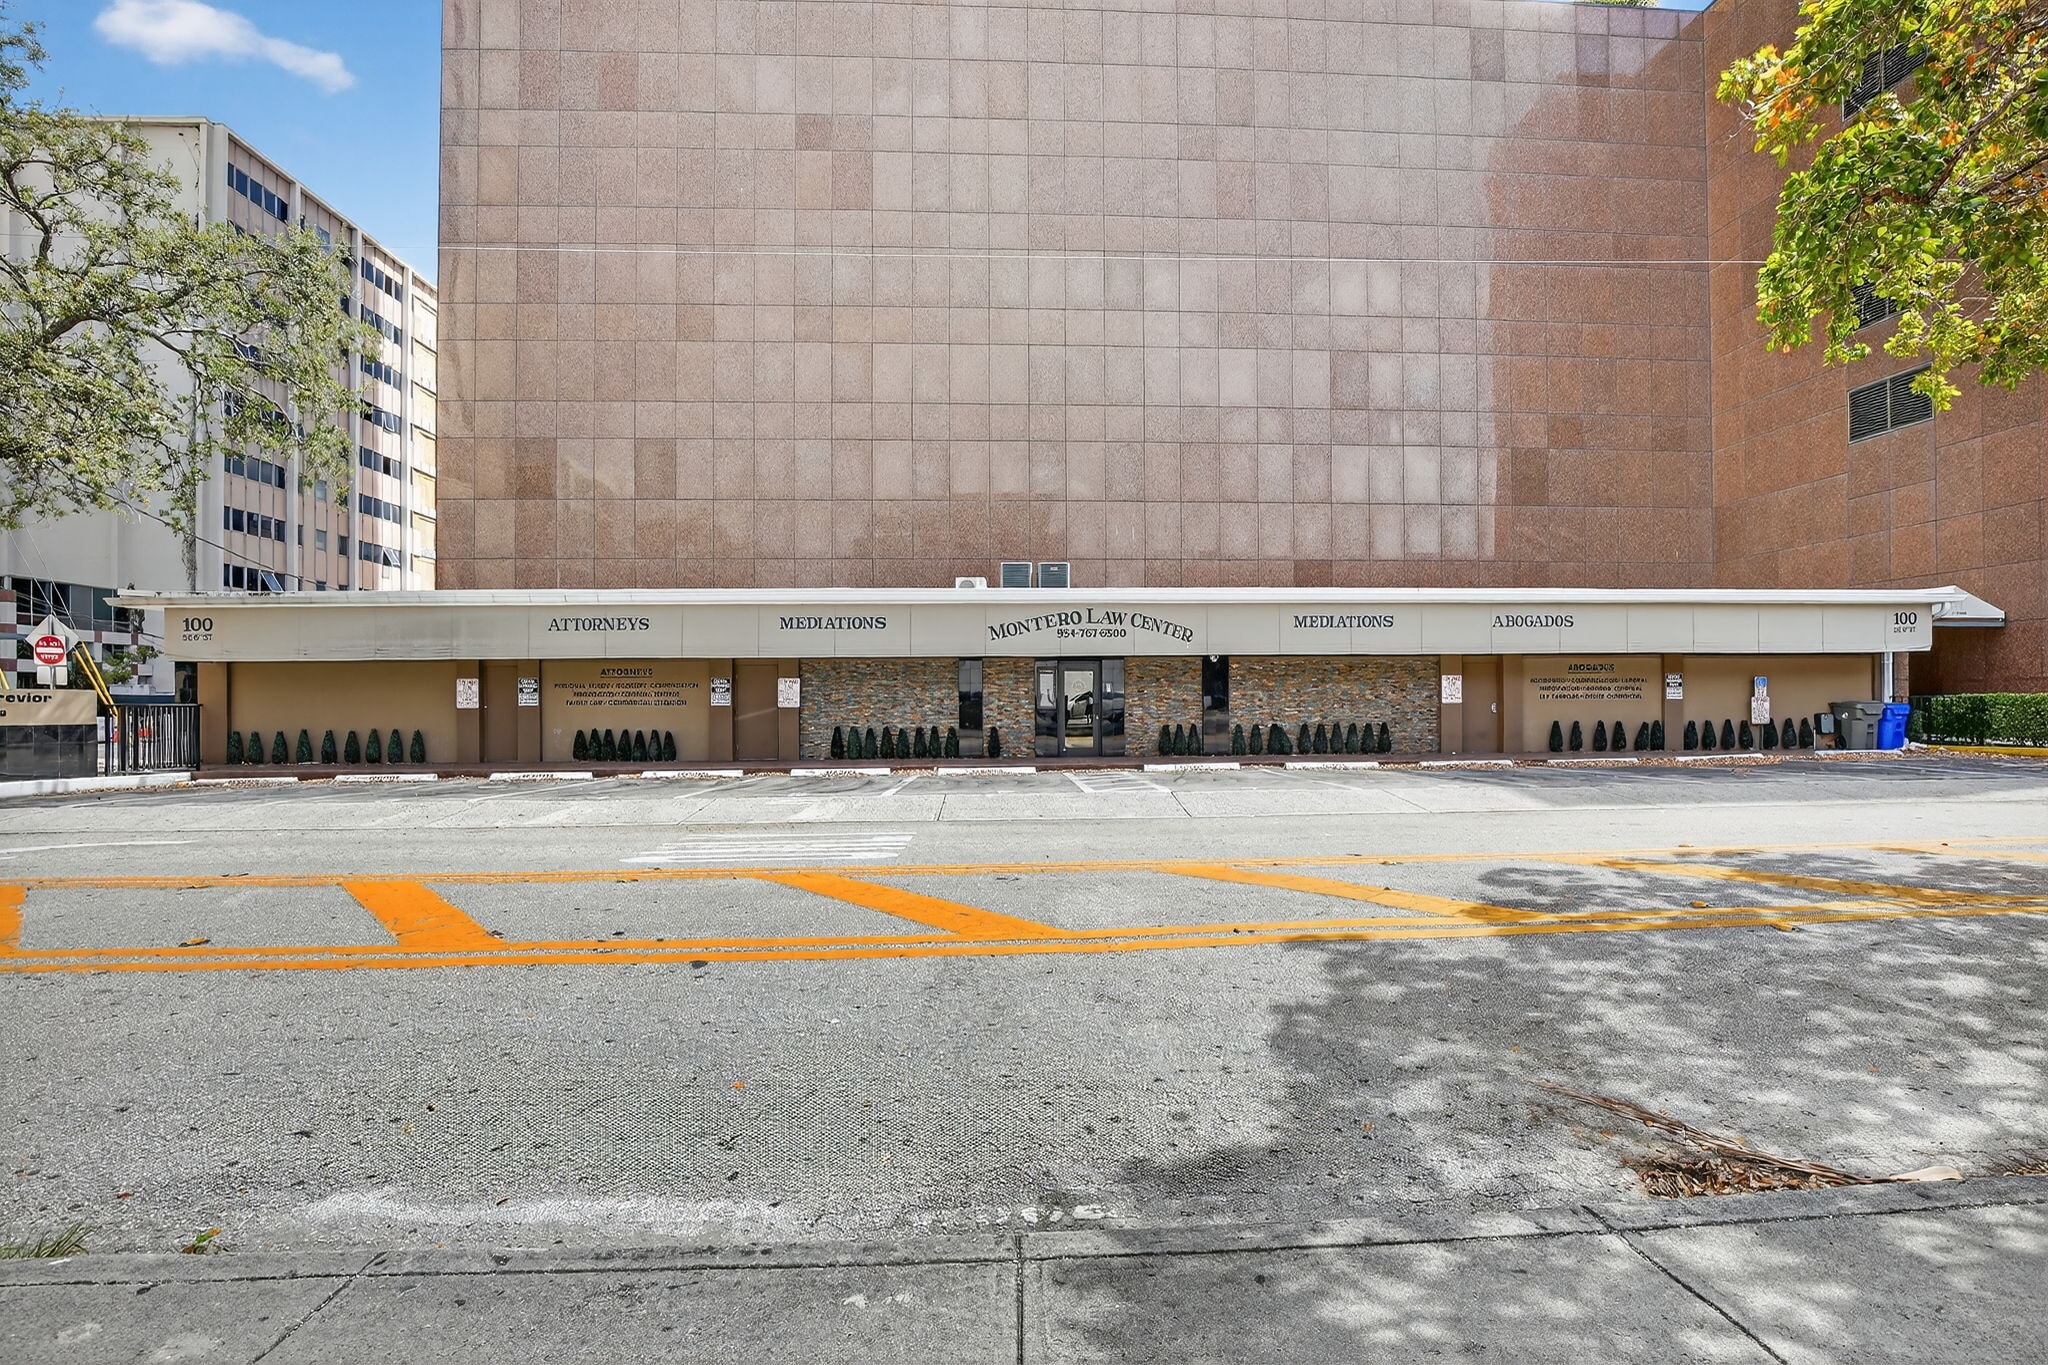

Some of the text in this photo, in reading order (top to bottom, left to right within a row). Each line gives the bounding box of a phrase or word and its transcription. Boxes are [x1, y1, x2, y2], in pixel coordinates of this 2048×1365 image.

[182, 617, 213, 632] 100
[548, 617, 650, 631] ATTORNEYS
[779, 616, 887, 630] MEDIATIONS
[988, 608, 1194, 642] MONTERO LAW CENTER
[1293, 615, 1394, 628] MEDIATIONS
[1492, 615, 1574, 627] ABOGADOS
[1893, 612, 1917, 625] 100
